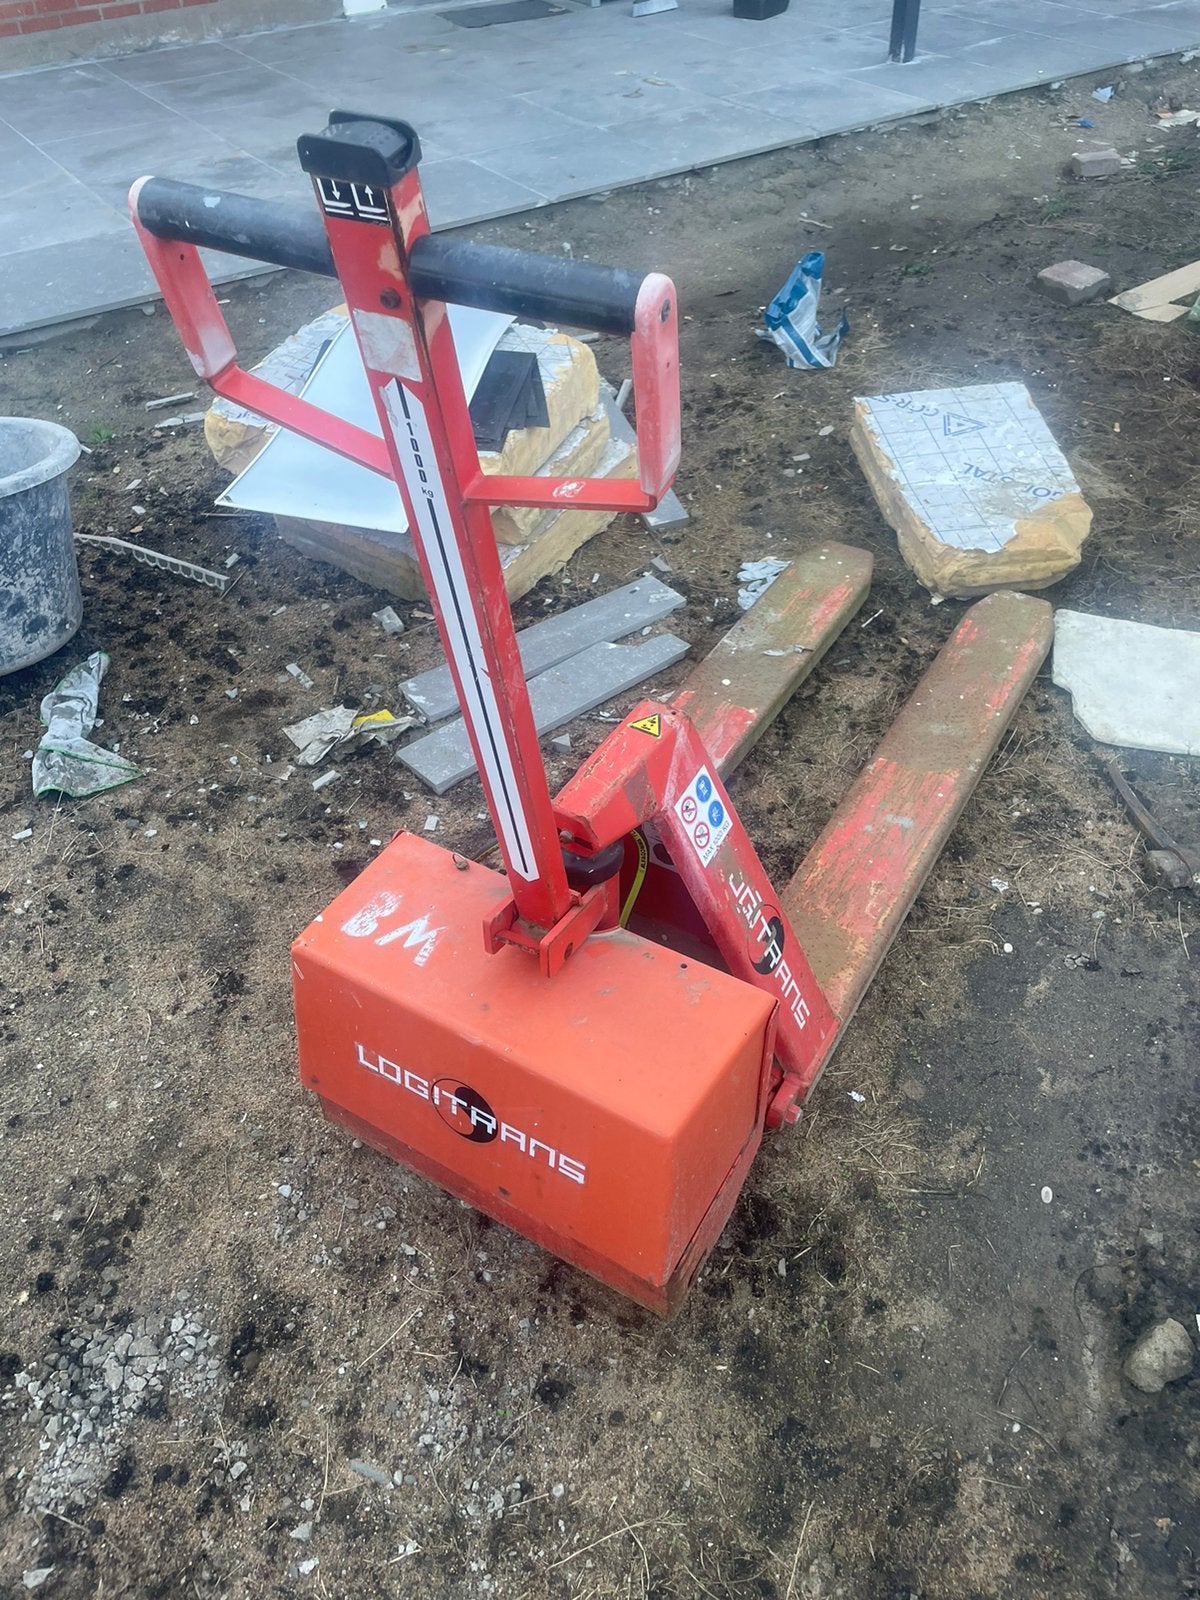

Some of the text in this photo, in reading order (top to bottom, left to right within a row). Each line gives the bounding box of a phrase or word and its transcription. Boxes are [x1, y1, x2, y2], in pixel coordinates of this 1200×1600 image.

[407, 422, 434, 499] 1000 kg
[355, 1041, 587, 1185] LOGITRANS
